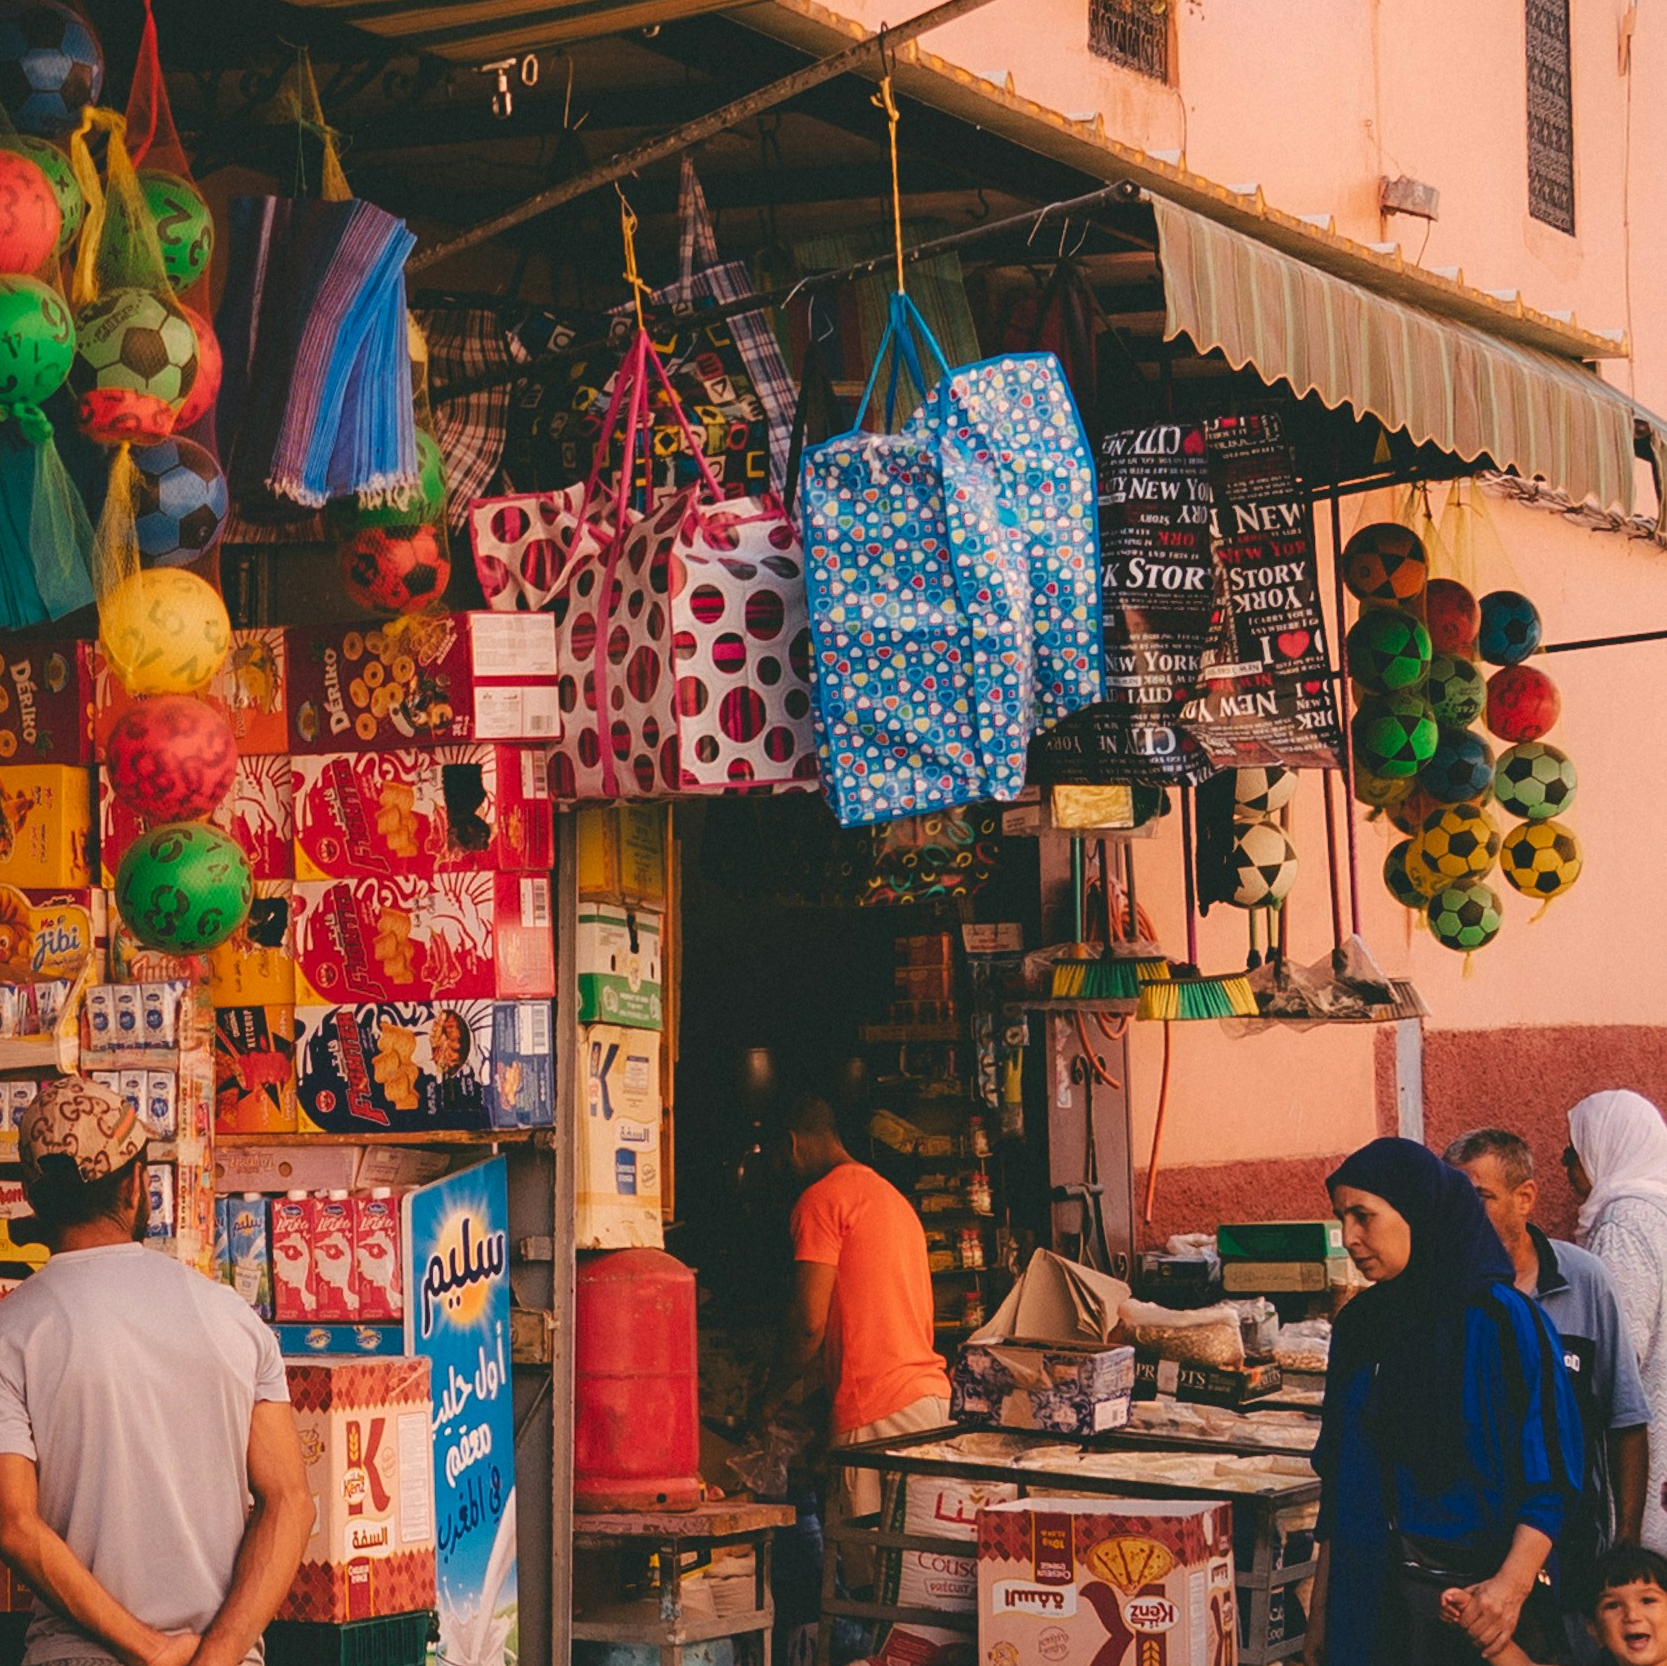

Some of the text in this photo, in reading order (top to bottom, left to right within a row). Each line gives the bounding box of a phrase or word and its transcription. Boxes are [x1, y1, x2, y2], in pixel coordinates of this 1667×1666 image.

[1129, 426, 1180, 455] CITY
[1130, 478, 1175, 501] NEW
[1234, 503, 1304, 534] NEW
[1157, 531, 1196, 547] ORK
[1127, 558, 1214, 590] STOR
[1229, 562, 1305, 590] STORY
[1234, 587, 1301, 613] YORK
[1143, 652, 1200, 672] YORK
[1260, 635, 1274, 664] I
[8, 659, 37, 745] DÉRIKO
[323, 647, 352, 736] DÉRIKO
[1136, 687, 1173, 703] CITY
[1219, 690, 1280, 717] NEW
[32, 925, 81, 973] Jibi
[242, 1008, 258, 1049] KETCHUP
[422, 1217, 505, 1337] سليم
[431, 1320, 506, 1440] أول حليب
[346, 1418, 391, 1517] K
[445, 1422, 493, 1489] معقم
[343, 1479, 365, 1500] Kenz
[437, 1461, 502, 1564] في المغرب
[352, 1526, 388, 1550] السفة
[918, 1551, 979, 1578] COUSC
[1004, 1587, 1065, 1610] السفة
[1131, 1602, 1174, 1623] Kenz
